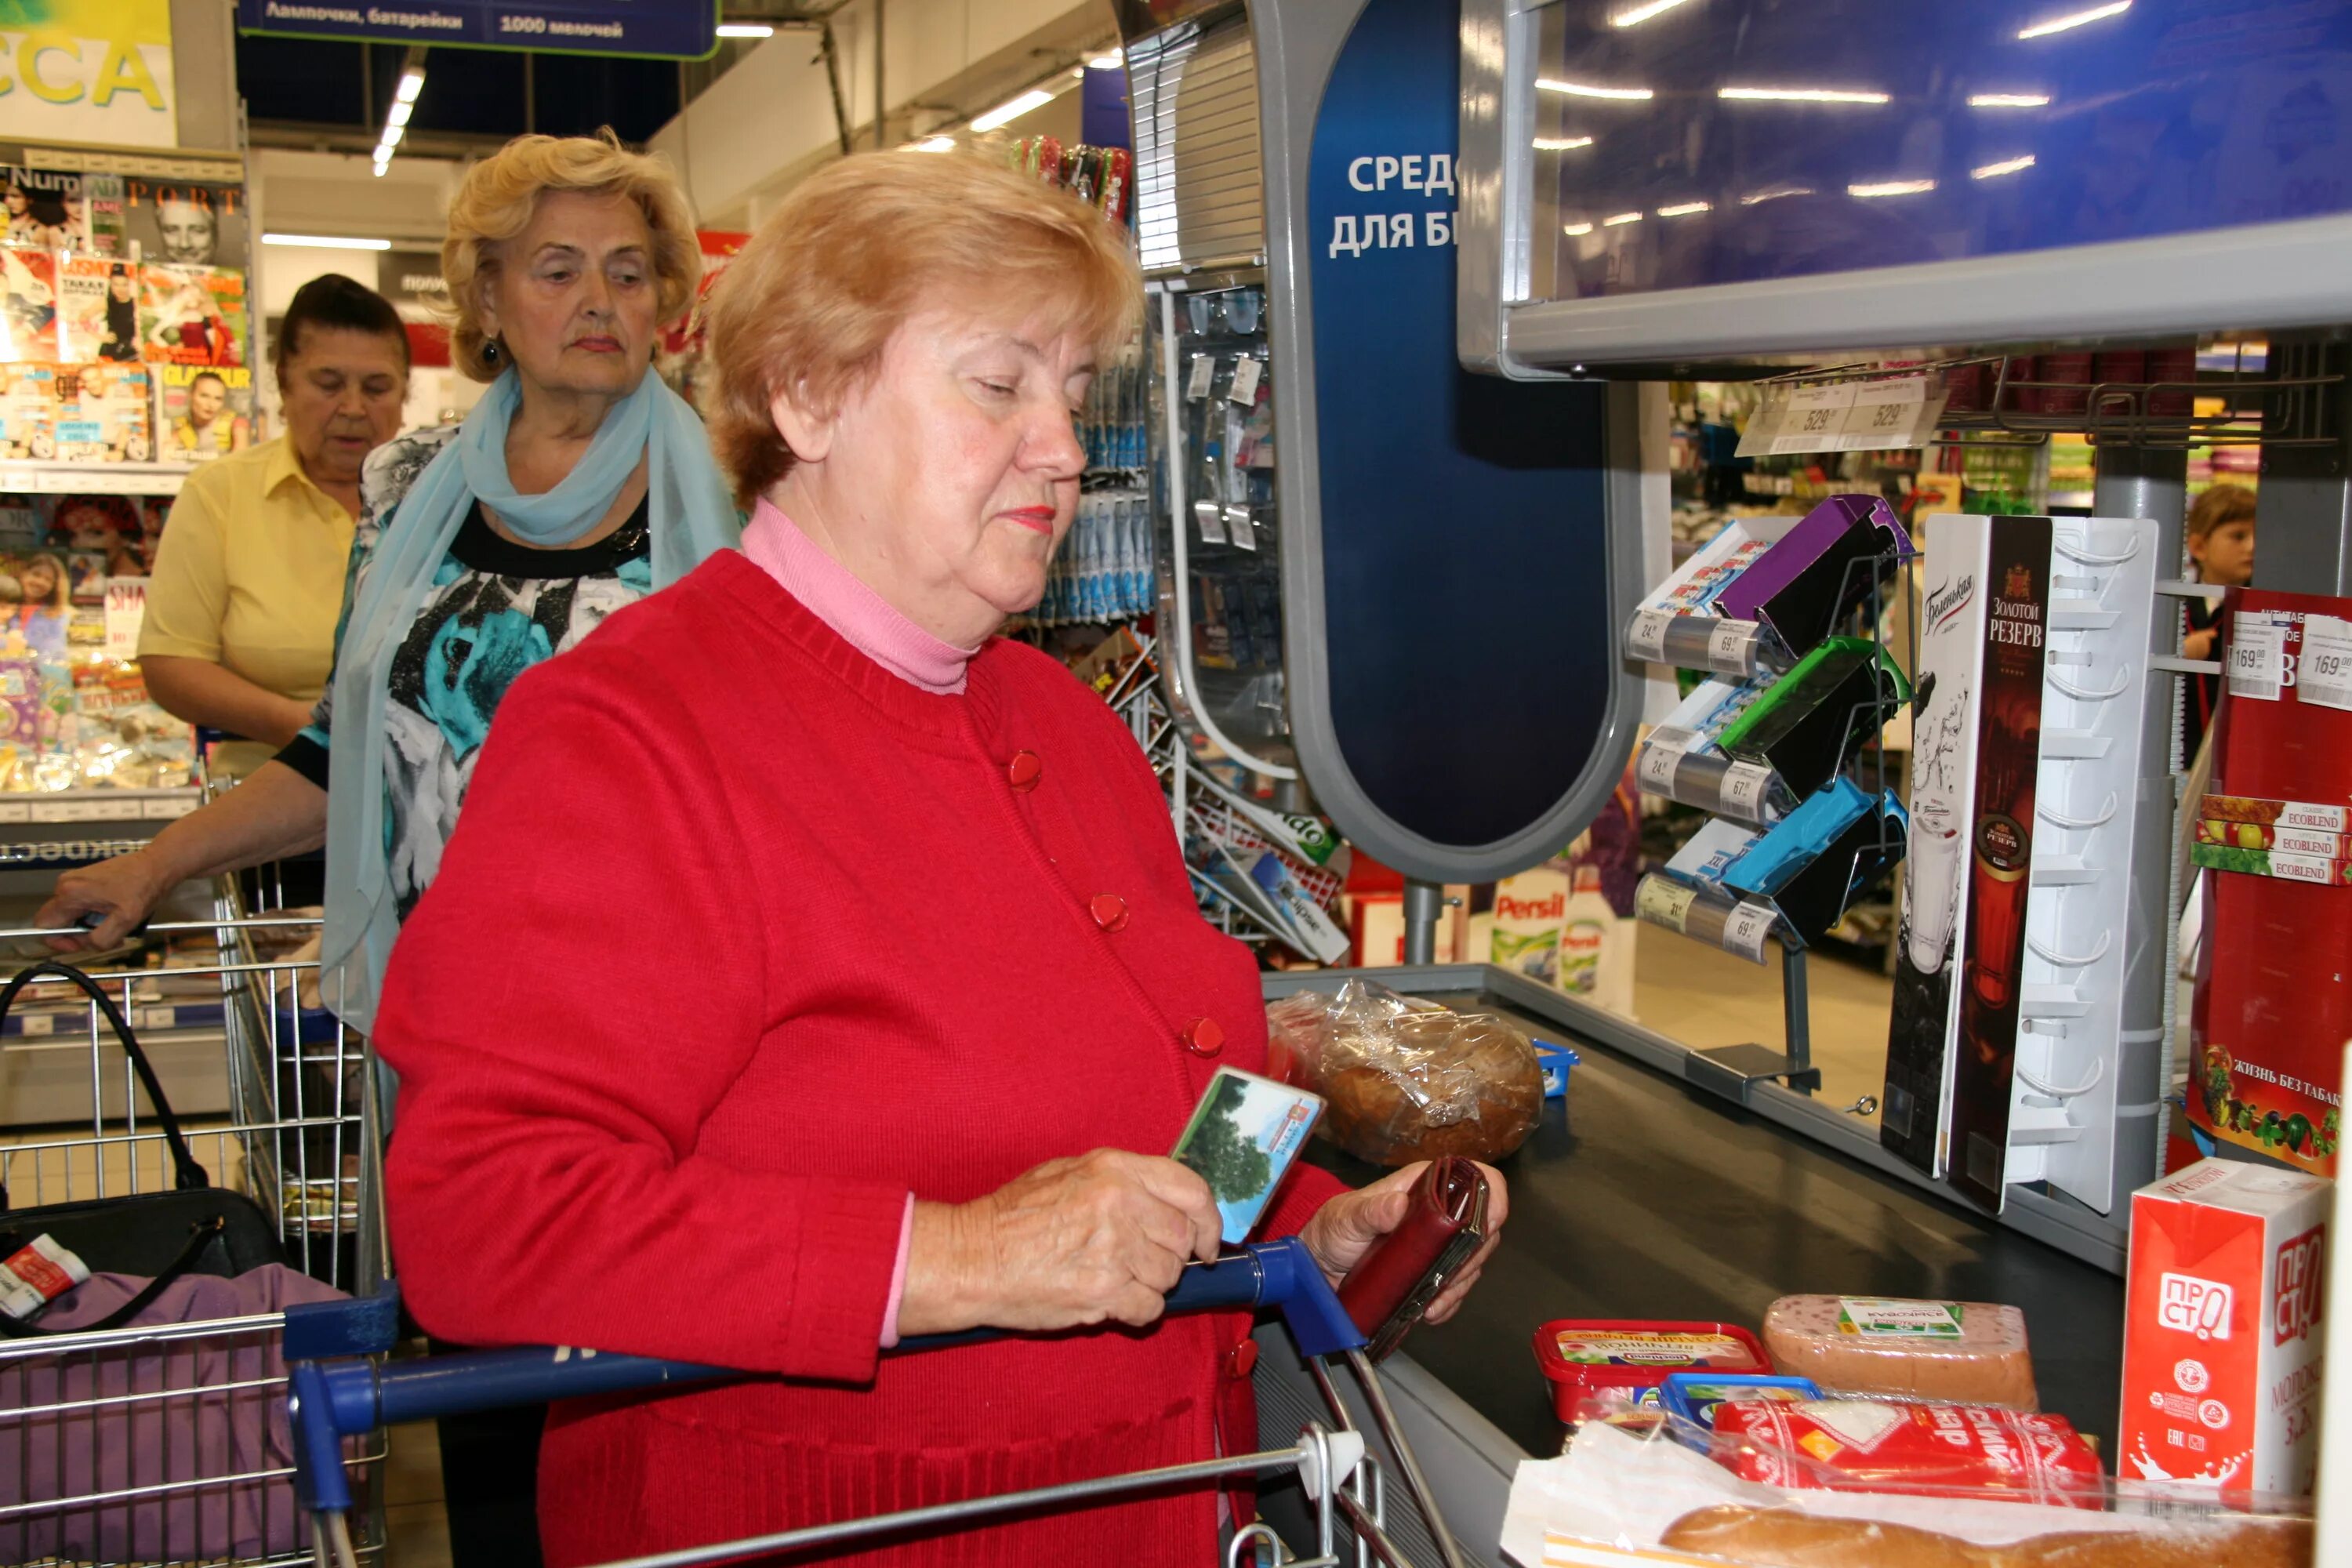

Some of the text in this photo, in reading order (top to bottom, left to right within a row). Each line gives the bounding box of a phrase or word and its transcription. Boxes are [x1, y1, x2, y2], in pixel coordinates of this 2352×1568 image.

[265, 2, 463, 31] Лампочки, батарейки
[499, 15, 546, 34] 1000
[0, 30, 167, 111] СА
[1348, 154, 1460, 197] СРЕД
[1329, 212, 1414, 259] ДЛЯ
[1803, 409, 1829, 431] 529
[1872, 404, 1900, 427] 529
[1641, 624, 1651, 638] 24
[1989, 619, 2042, 648] РЕЗЕРВ
[1721, 636, 1732, 652] 69
[2235, 649, 2256, 668] 169
[2314, 655, 2339, 676] 169
[1651, 760, 1662, 775] 24
[1732, 781, 1745, 797] 67
[2288, 813, 2339, 828] ECOBLEND
[2282, 838, 2332, 855] ECOBLEND
[2275, 862, 2325, 880] ECOBLEND
[1497, 891, 1564, 920] Persil
[1737, 920, 1749, 937] 69
[2234, 1058, 2277, 1083] ЖИЗНЬ
[2279, 1074, 2302, 1092] БЕЗ
